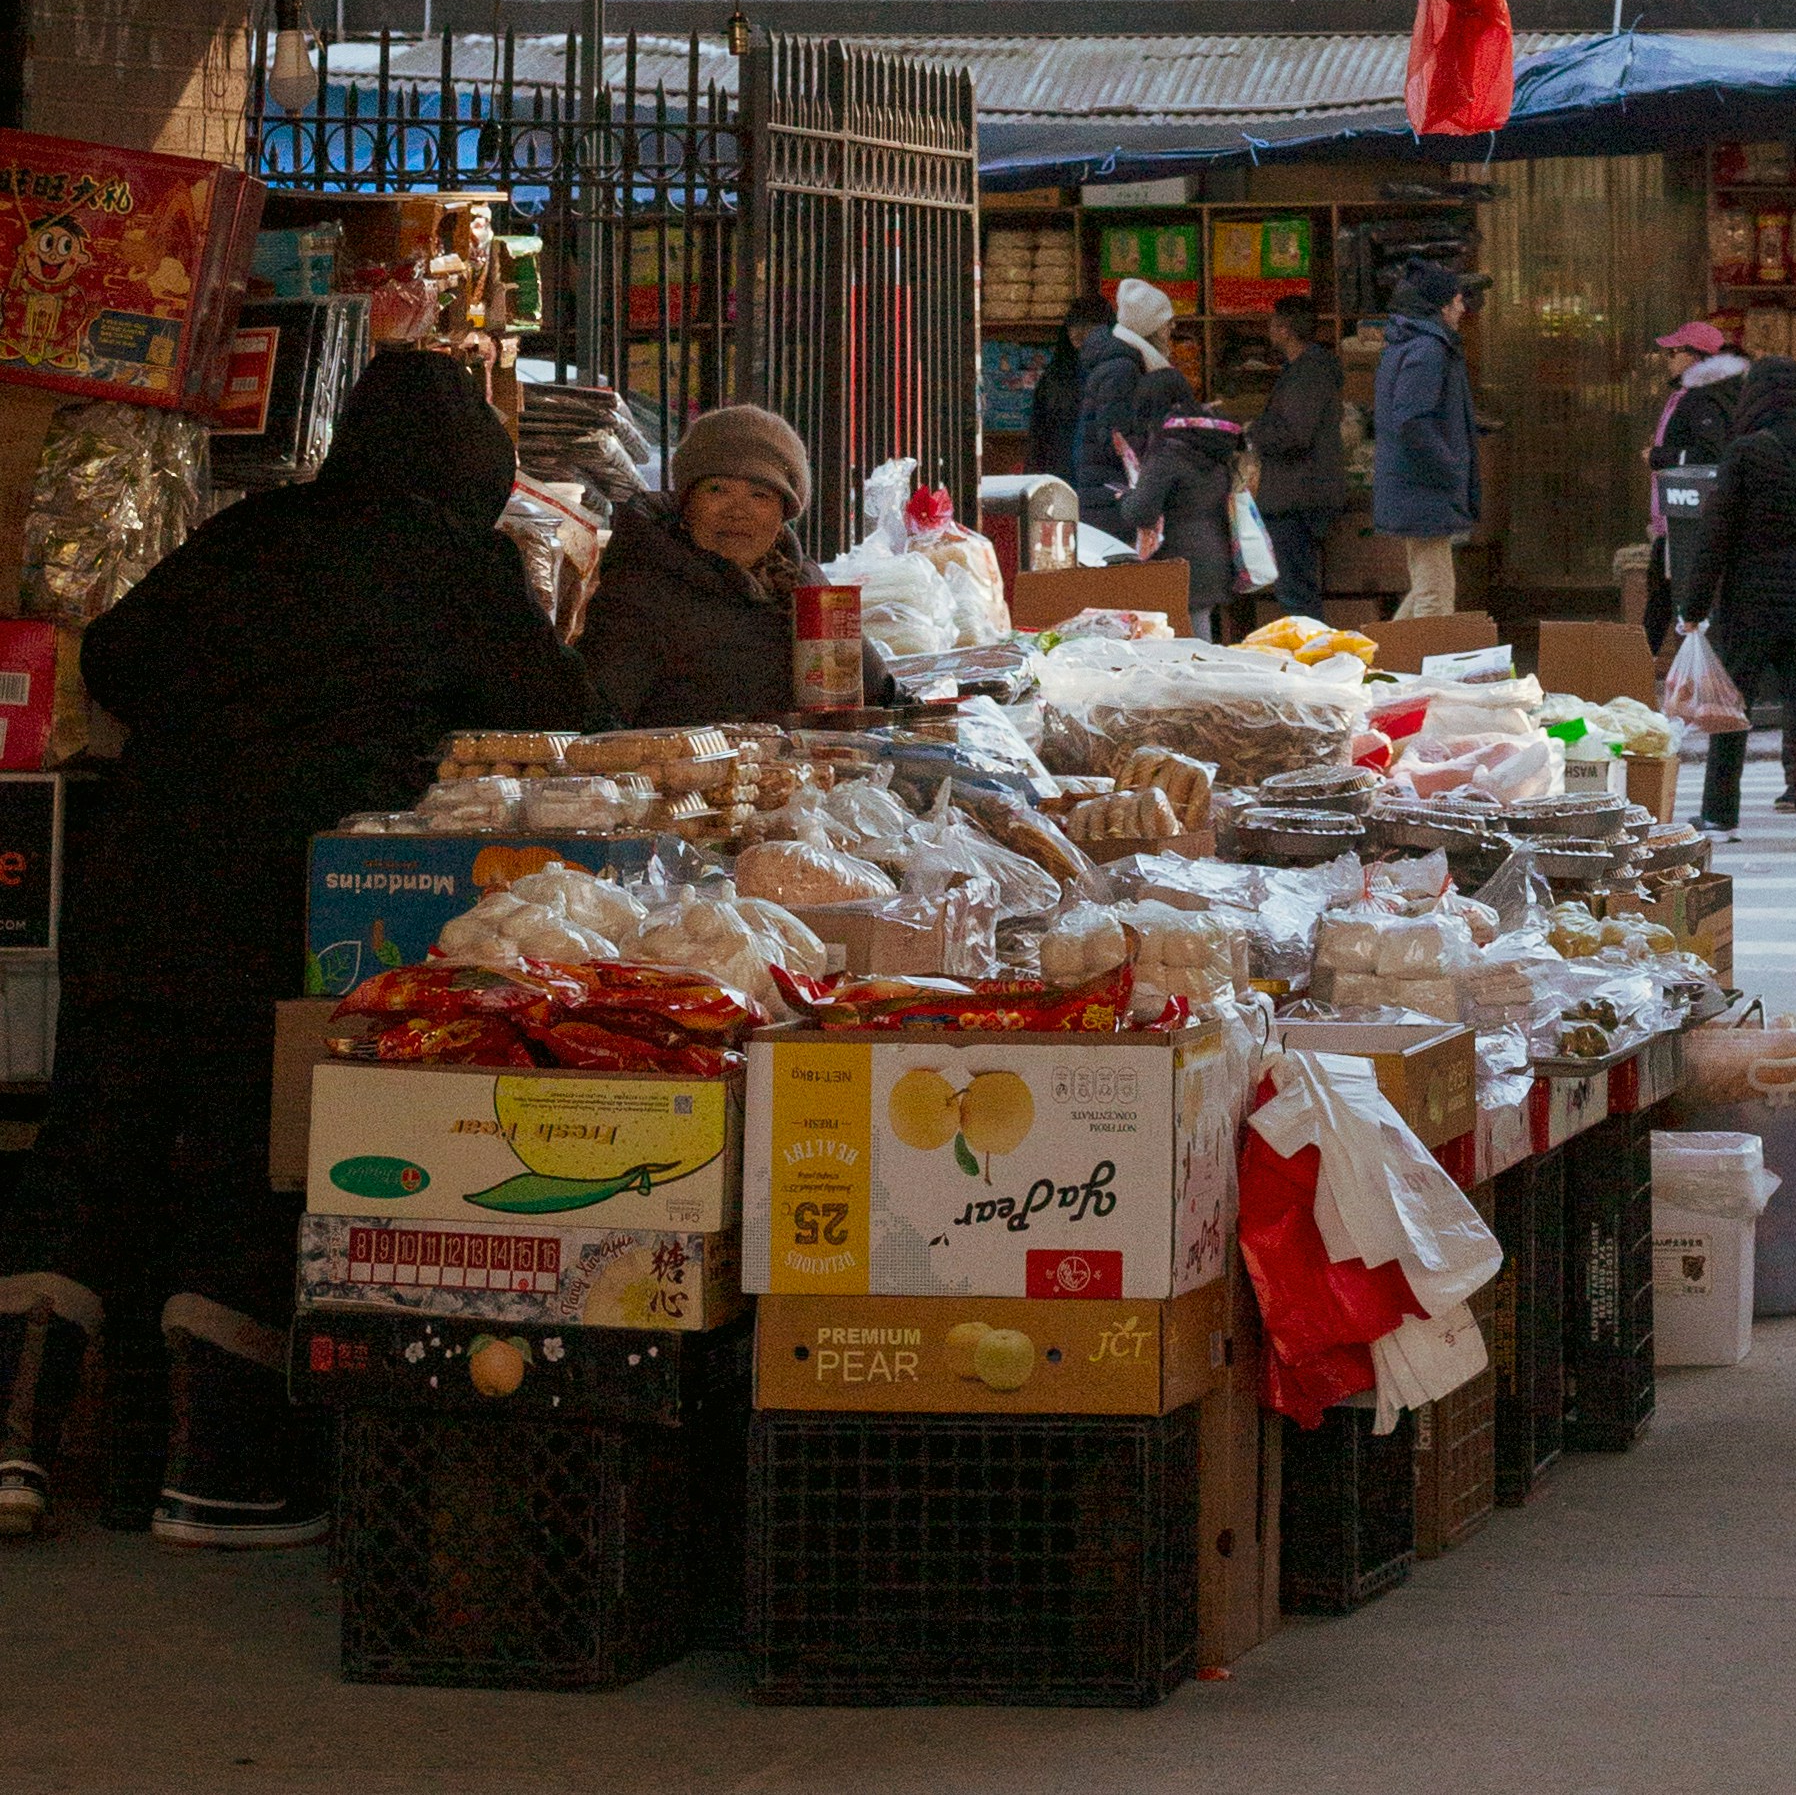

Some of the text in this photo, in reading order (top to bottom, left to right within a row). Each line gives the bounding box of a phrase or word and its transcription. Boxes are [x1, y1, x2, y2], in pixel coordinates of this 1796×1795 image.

[325, 872, 455, 896] Mandarins
[791, 1067, 853, 1083] NET:18kg
[803, 1118, 839, 1129] FRESH
[1070, 1110, 1138, 1120] CONCENTRATE
[449, 1118, 618, 1146] Fresh Pear
[1089, 1122, 1137, 1133] NOT FROM
[783, 1138, 860, 1167] HEALTHY
[356, 1235, 557, 1268] 8 9 10 11 12 13 14 15 16
[784, 1250, 856, 1275] DELICIOUS
[650, 1240, 690, 1318] 糖心
[817, 1327, 922, 1346] PREMIUM
[816, 1350, 920, 1383] PEAR
